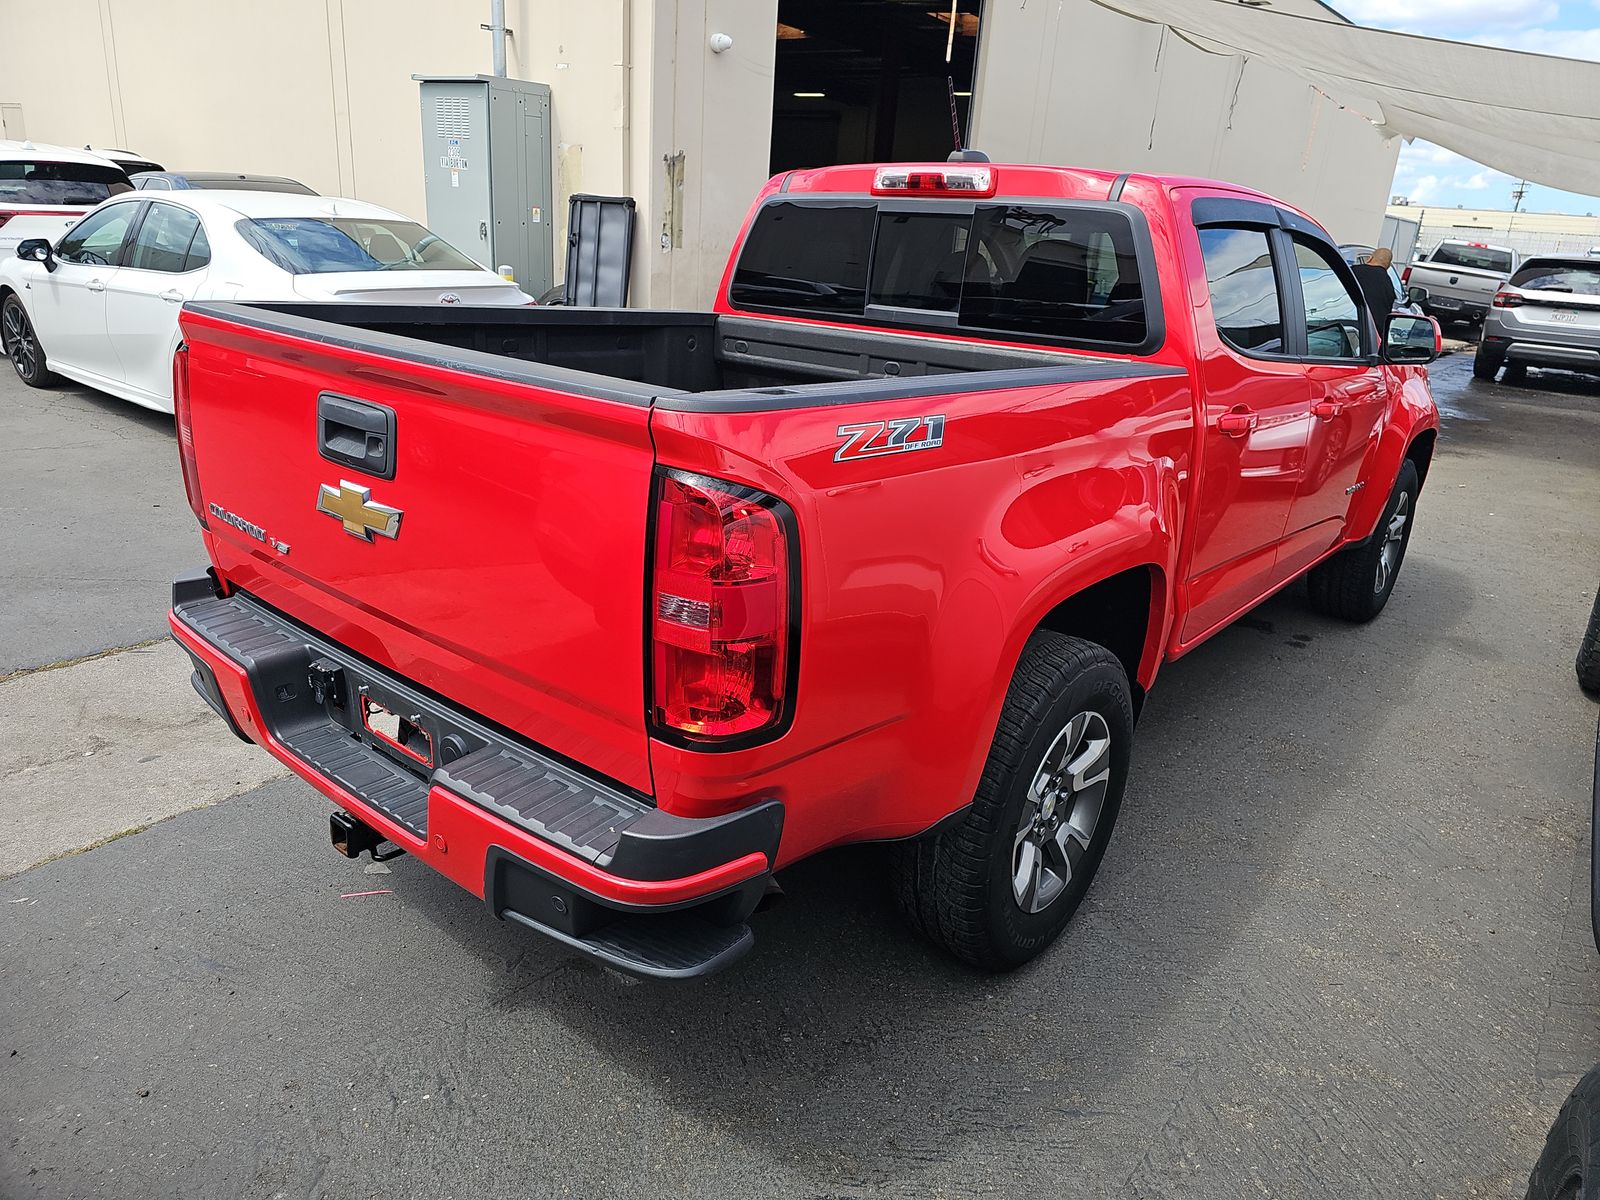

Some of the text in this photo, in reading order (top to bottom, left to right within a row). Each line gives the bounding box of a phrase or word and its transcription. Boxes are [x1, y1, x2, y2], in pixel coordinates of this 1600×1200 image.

[833, 414, 946, 463] Z71
[904, 439, 942, 451] OFF ROAD
